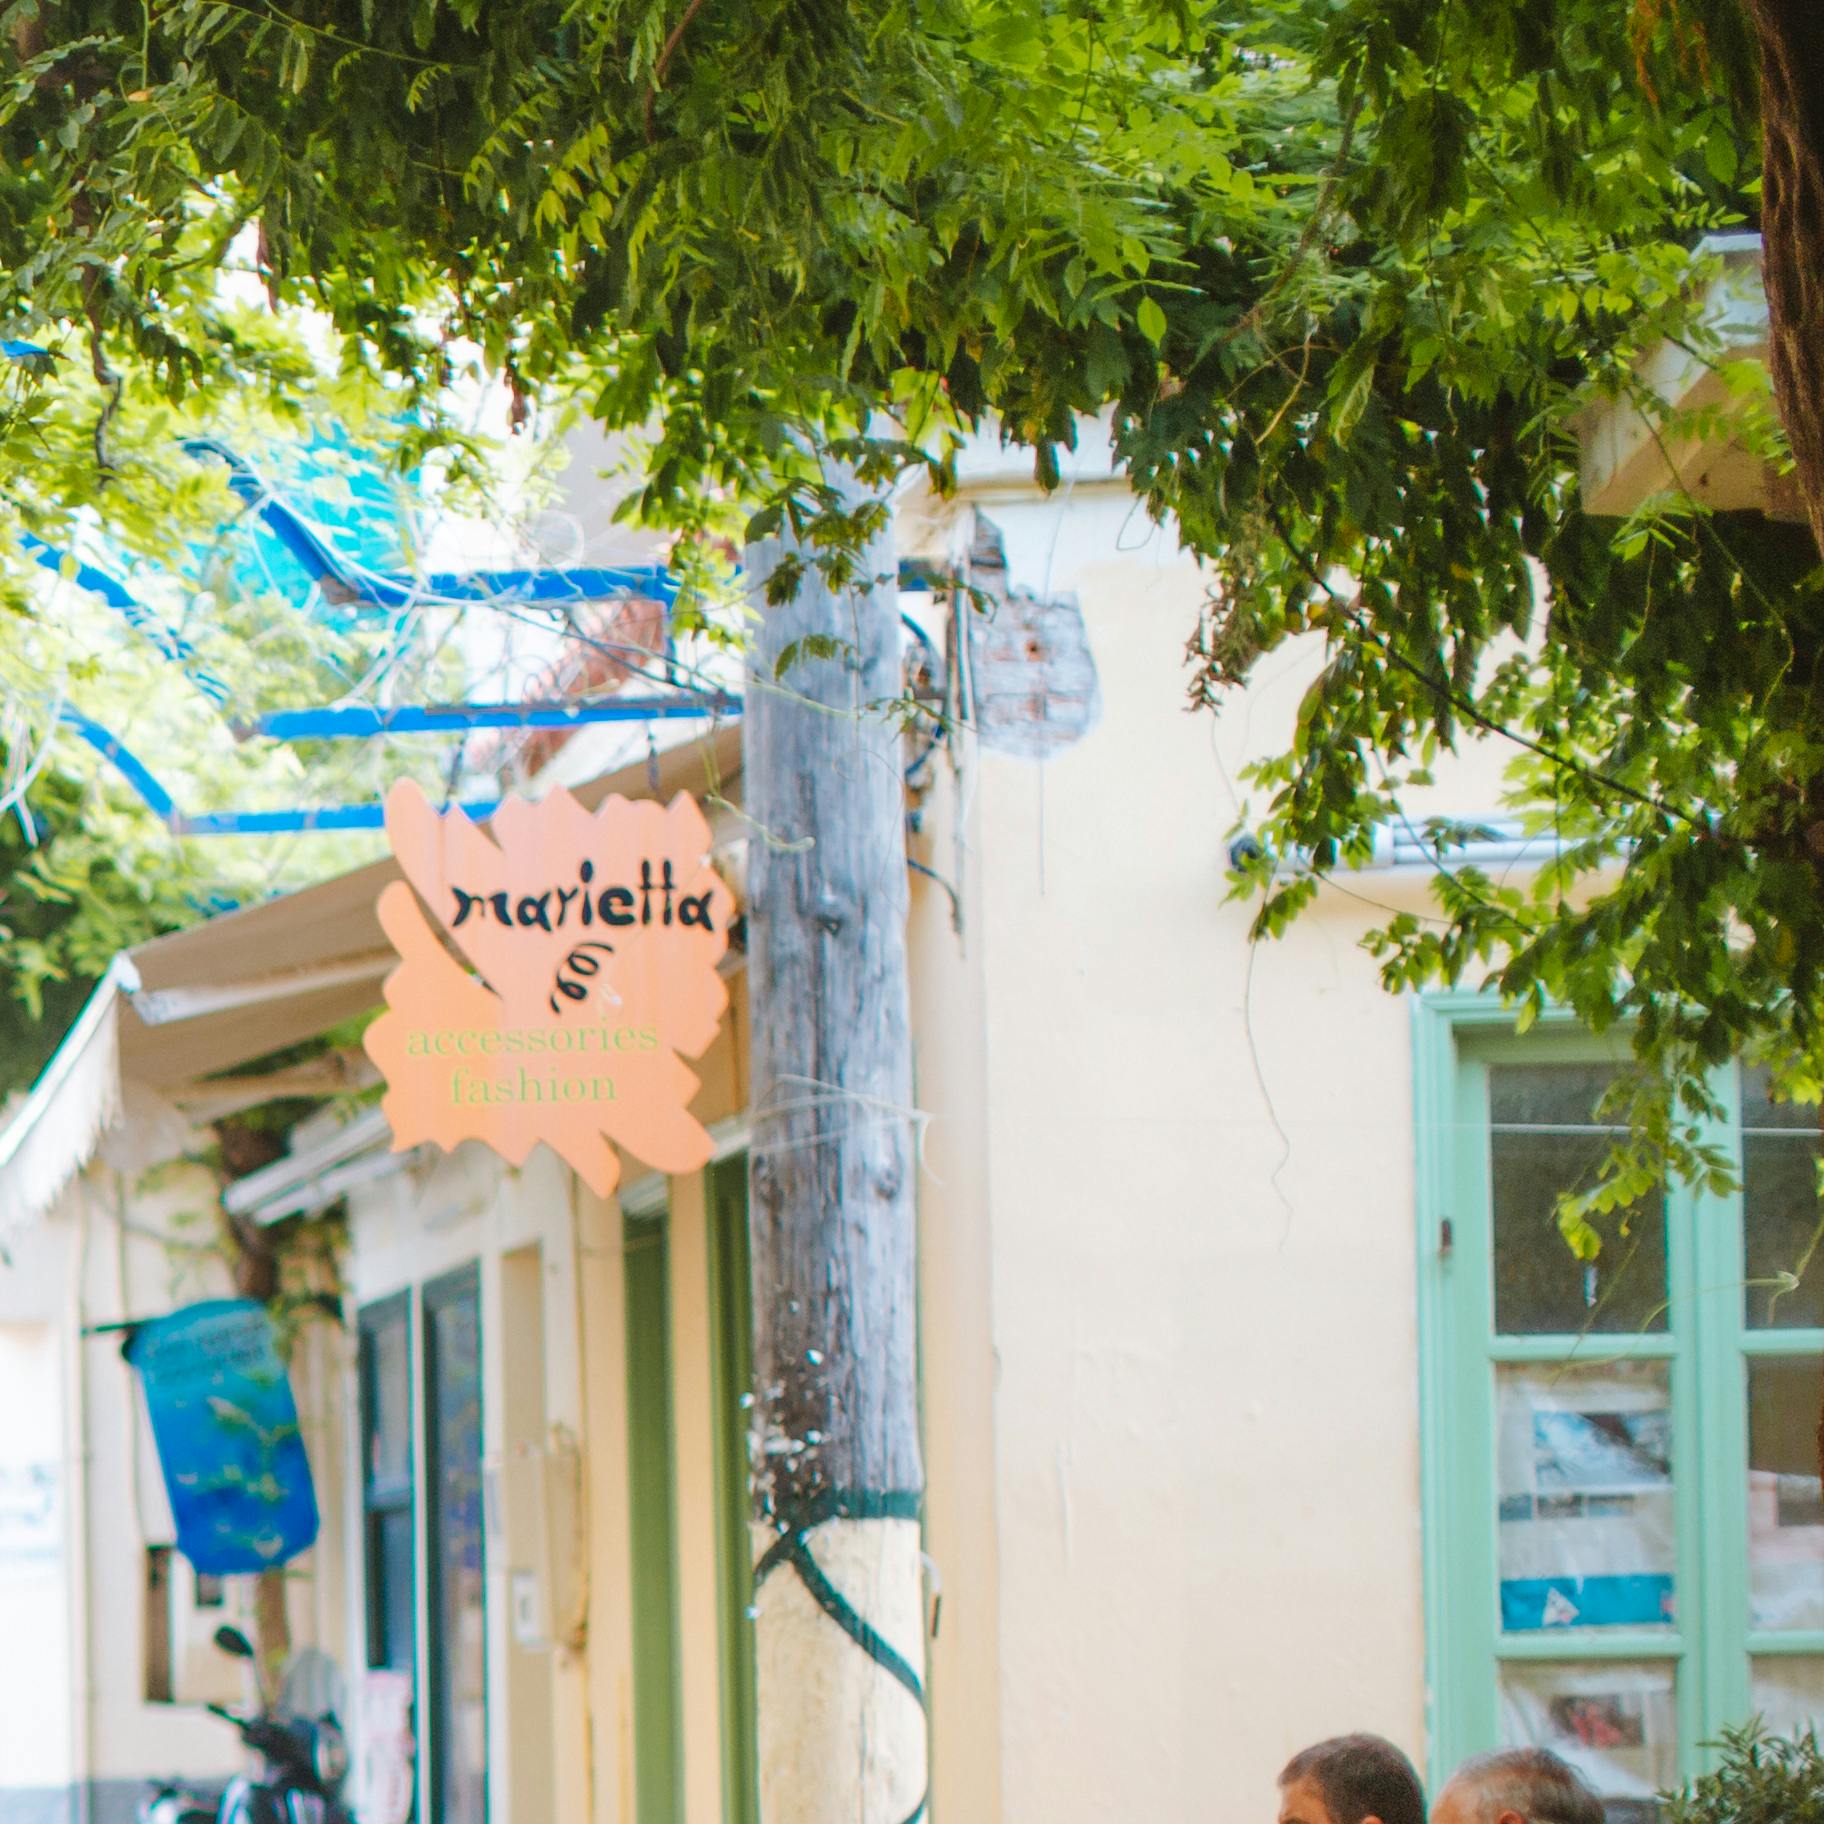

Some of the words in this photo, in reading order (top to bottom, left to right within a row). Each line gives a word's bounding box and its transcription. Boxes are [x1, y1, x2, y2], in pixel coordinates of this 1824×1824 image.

[451, 859, 715, 933] marietta
[406, 1017, 659, 1057] accessories
[451, 1066, 619, 1105] fashion
